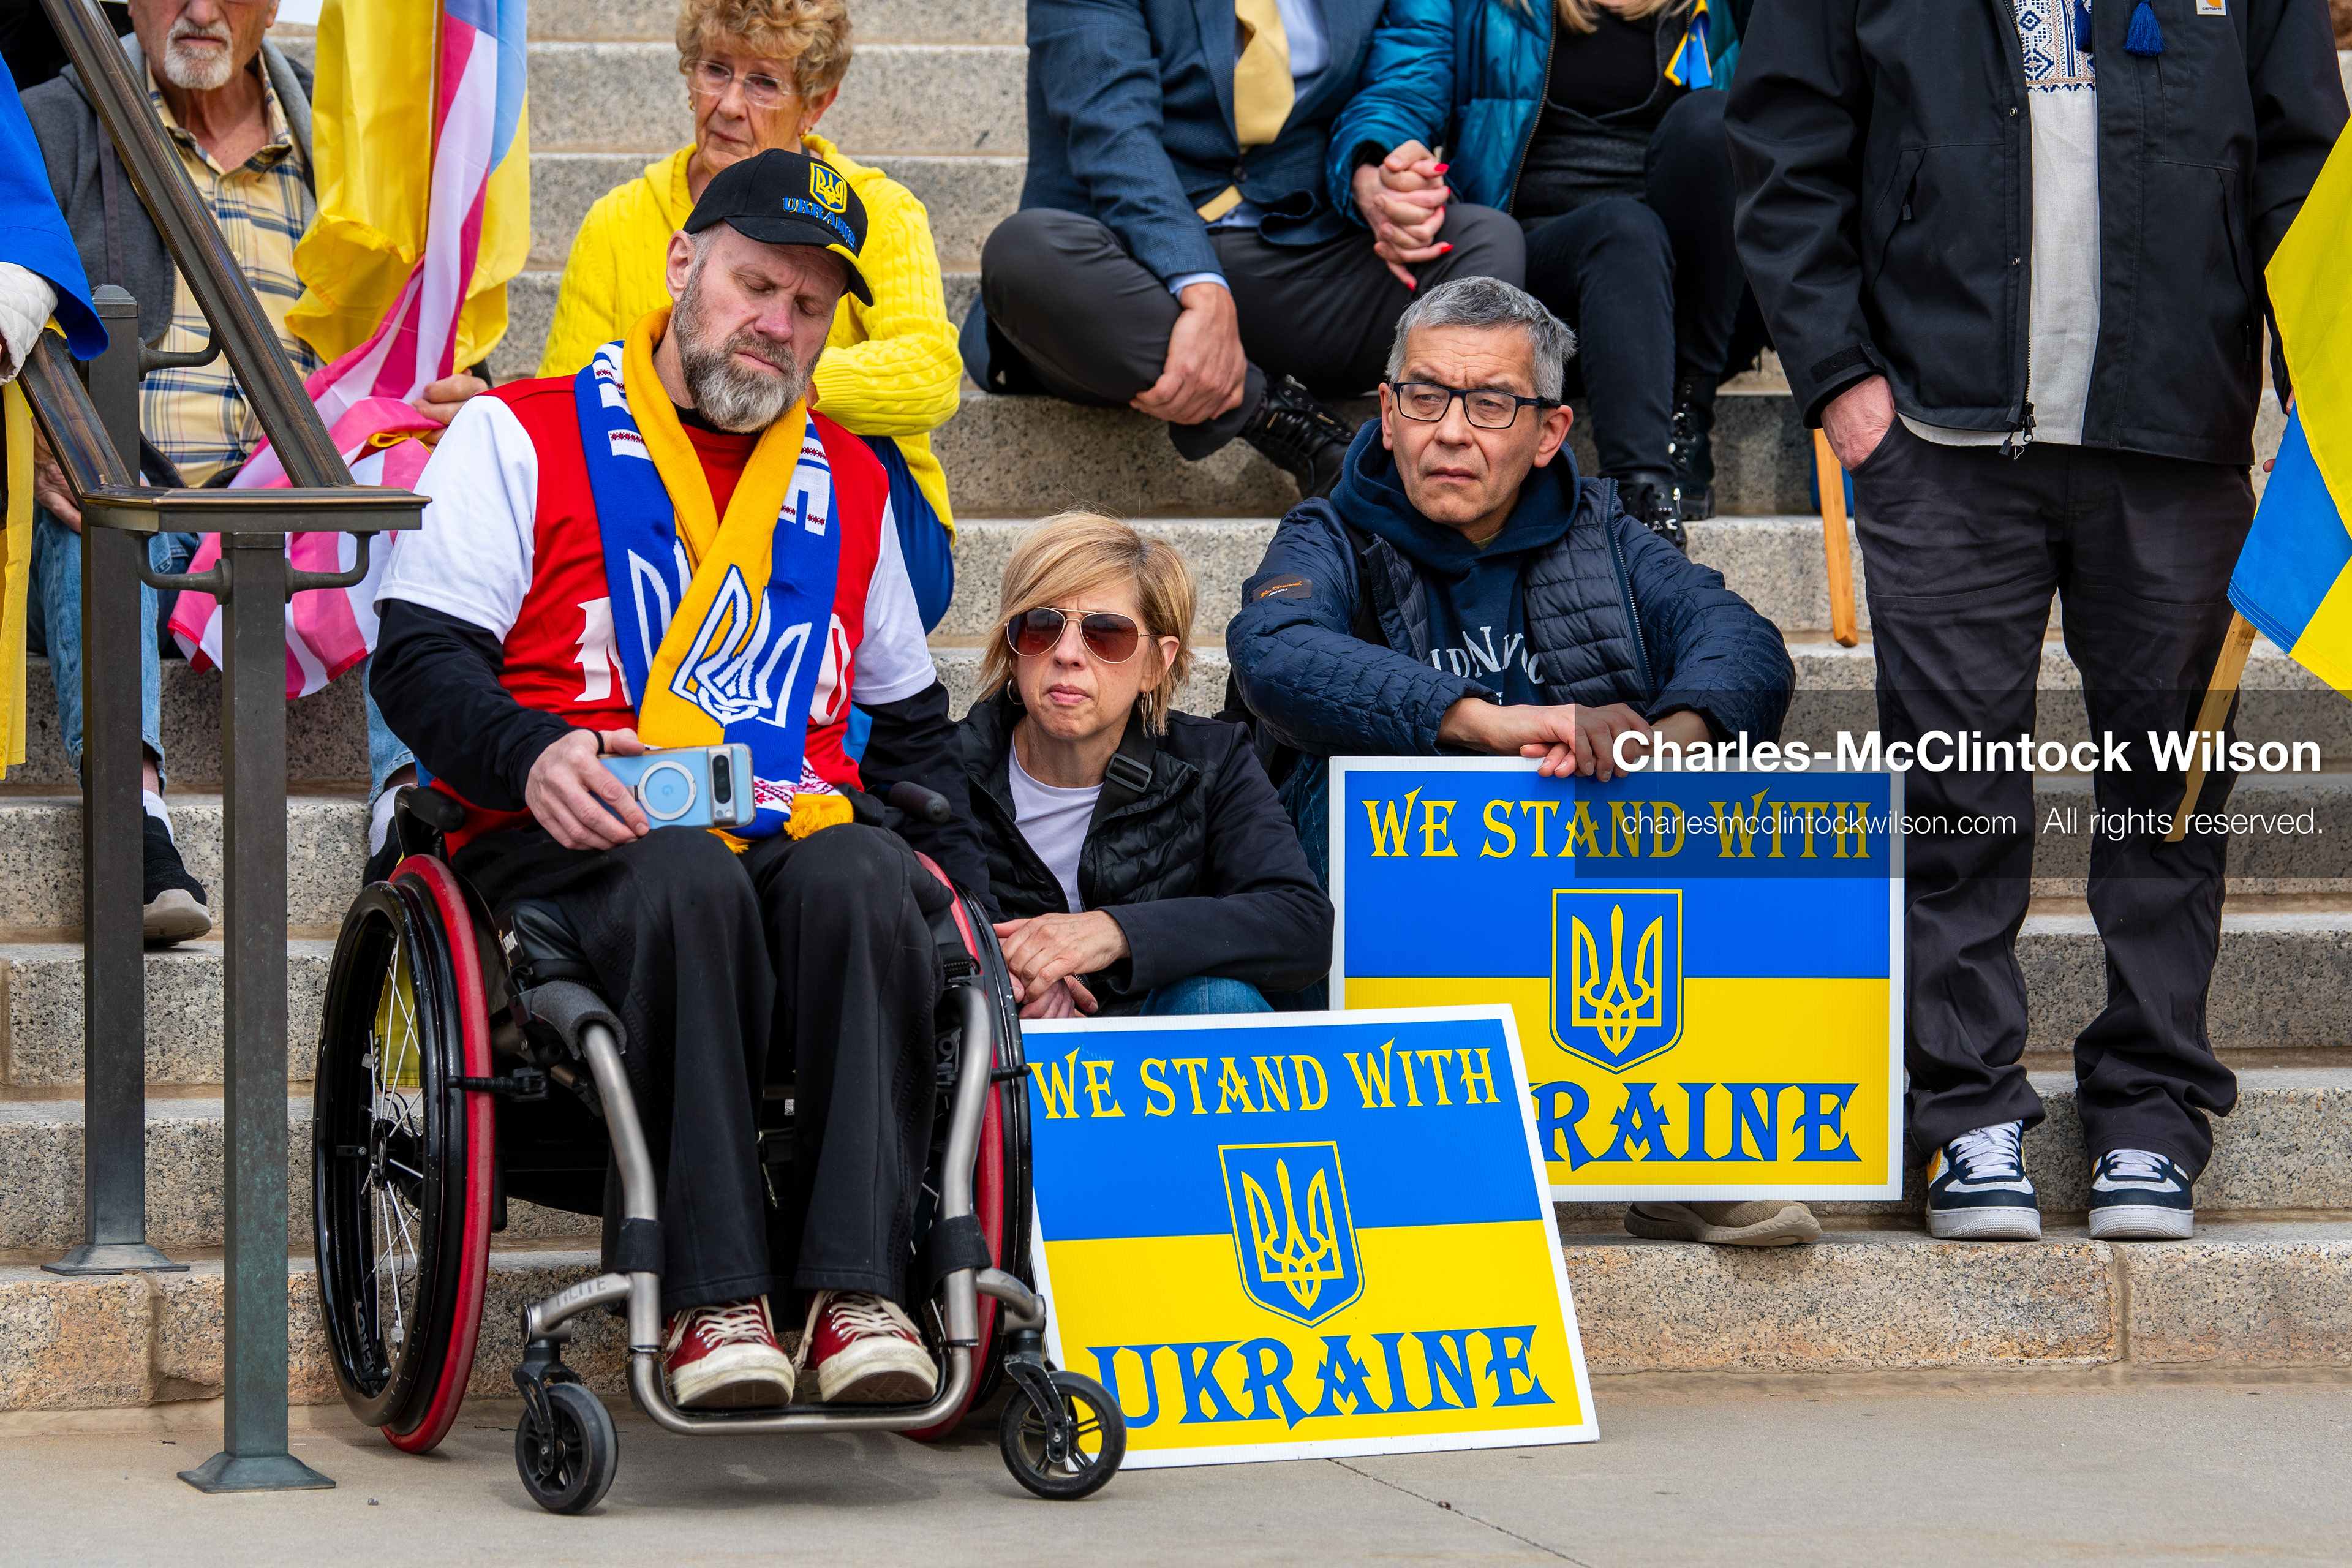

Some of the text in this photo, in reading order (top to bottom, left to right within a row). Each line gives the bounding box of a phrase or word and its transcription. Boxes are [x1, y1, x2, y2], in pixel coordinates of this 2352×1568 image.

[783, 197, 856, 249] UKRAINE
[1359, 780, 1873, 862] WE STAND WITH
[1027, 1033, 1501, 1120] WE STAND WITH
[1529, 1080, 1863, 1172] RAINE
[1085, 1325, 1555, 1430] UKRAINE
